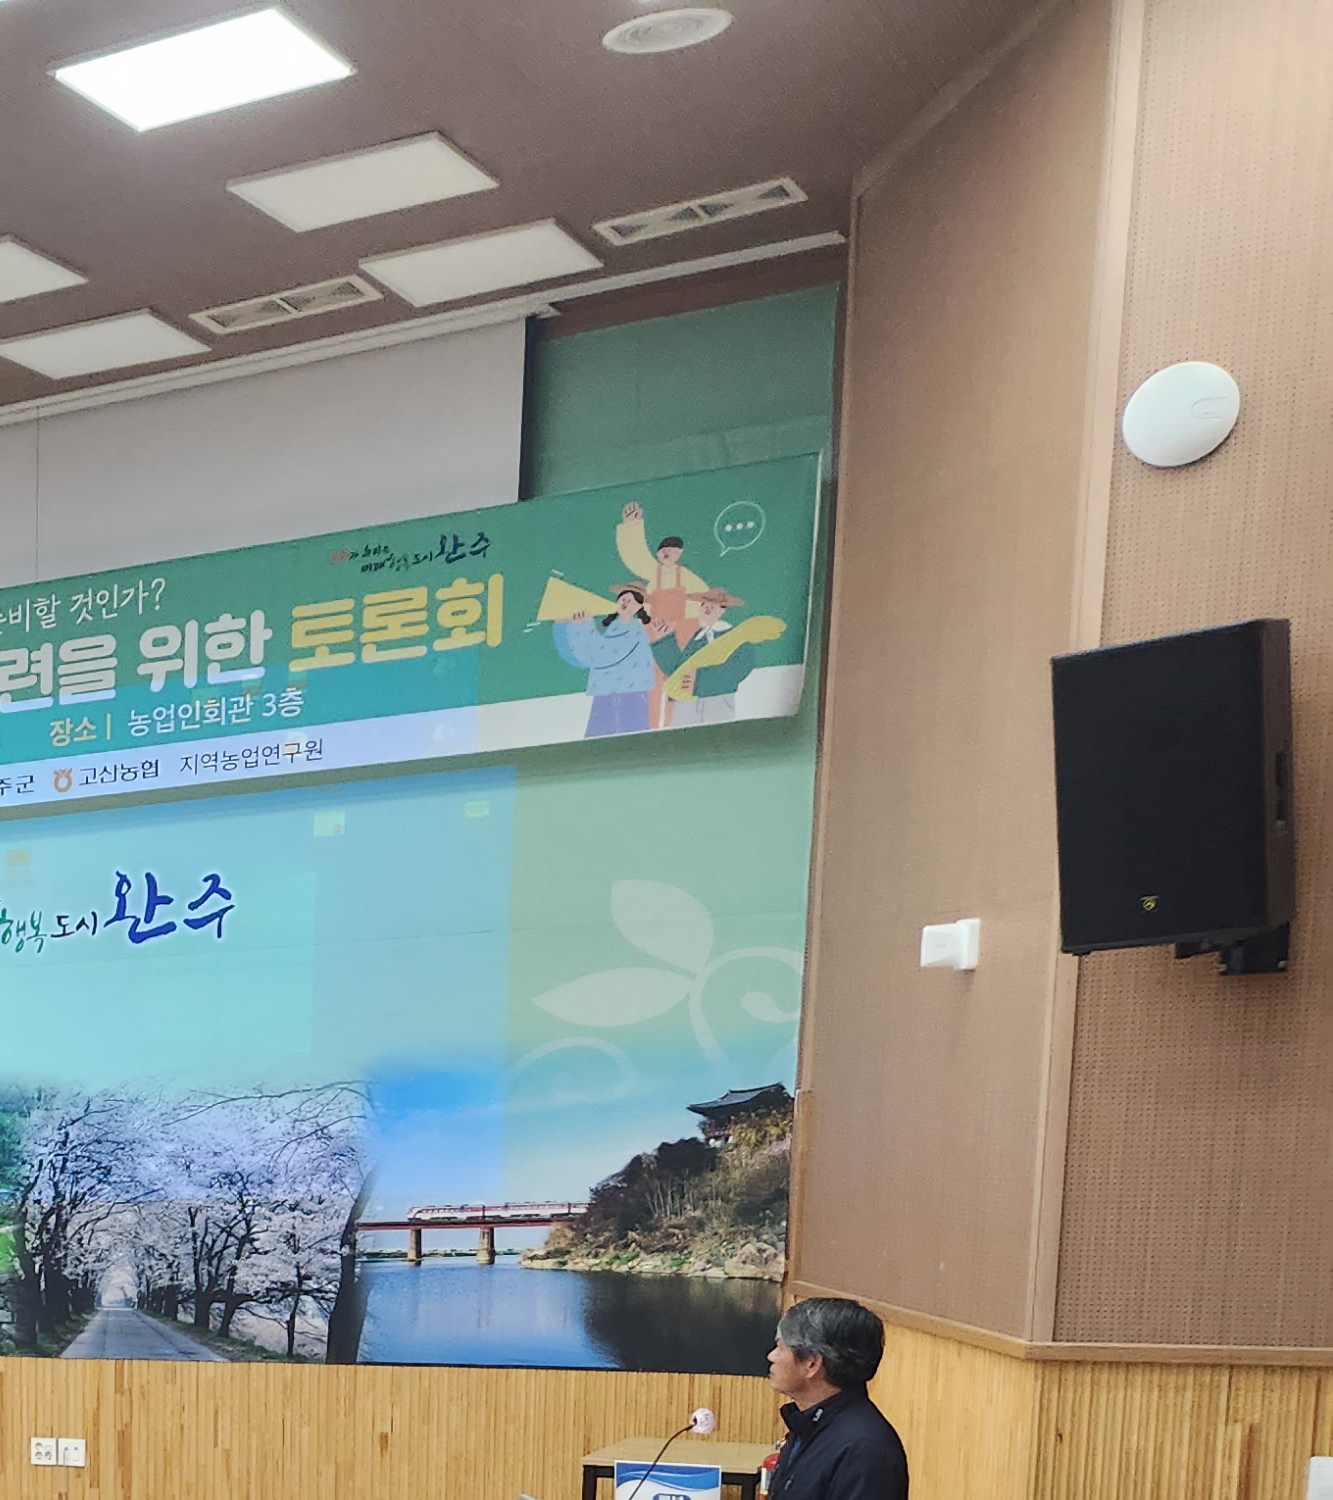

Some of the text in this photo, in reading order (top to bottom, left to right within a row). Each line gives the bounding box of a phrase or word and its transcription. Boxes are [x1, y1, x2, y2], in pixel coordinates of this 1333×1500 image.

[434, 531, 491, 564] 완주
[69, 577, 166, 624] 것인가?
[135, 609, 274, 692] 위한
[289, 573, 504, 673] 토론회
[49, 687, 304, 748] 장소 농업인회관 3층
[78, 738, 324, 787] 고산농협 지역농업연구원
[50, 910, 99, 938] 도시
[103, 869, 236, 944] 완주
